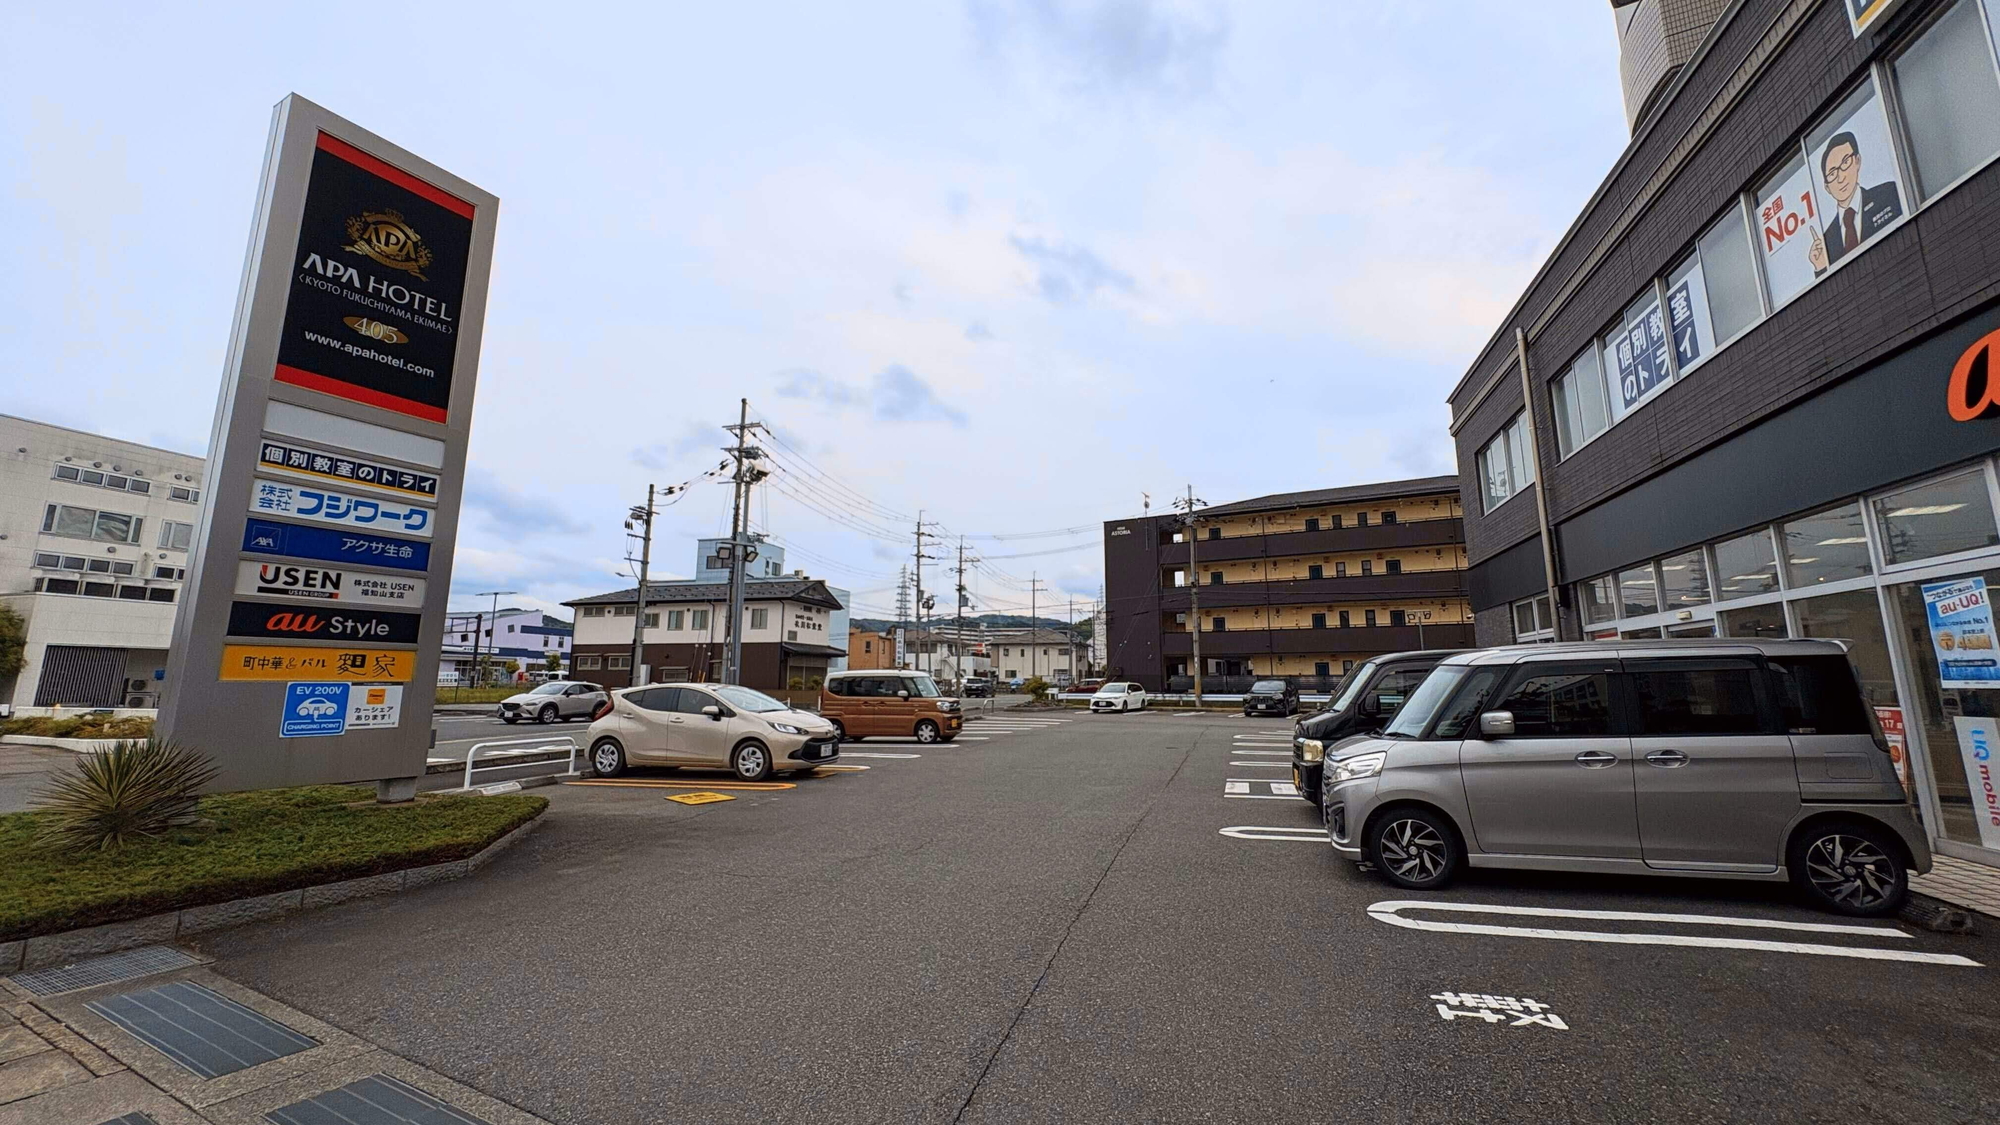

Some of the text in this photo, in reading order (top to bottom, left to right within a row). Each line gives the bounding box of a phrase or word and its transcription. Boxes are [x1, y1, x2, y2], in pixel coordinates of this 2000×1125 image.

[1761, 195, 1784, 223] 全国
[1763, 191, 1815, 253] No.1
[302, 252, 361, 289] APA
[367, 275, 453, 321] HOTEL
[342, 288, 412, 321] FUKUCHIYAMA
[353, 318, 399, 344] 405
[1618, 291, 1690, 370] 個別教室
[304, 330, 435, 378] www.apahotel.com
[263, 445, 436, 494] 個別教室のトライ
[260, 484, 293, 499] 株式
[258, 497, 291, 512] 会社
[296, 489, 428, 531] フジワーク
[251, 536, 274, 548] AXA
[340, 538, 414, 559] アクサ生命
[258, 564, 342, 591] USEN
[353, 579, 415, 592] 株式会社 USEN
[309, 591, 330, 599] GROUP
[360, 588, 405, 599] 福知山支店
[266, 612, 390, 637] au Style
[1972, 616, 1989, 625] No.1
[296, 686, 343, 695] EV 200V
[353, 706, 394, 714] カーシェア
[287, 723, 320, 731] CHARGING
[320, 722, 341, 730] POINT
[1970, 729, 2000, 828] UQ mobile
